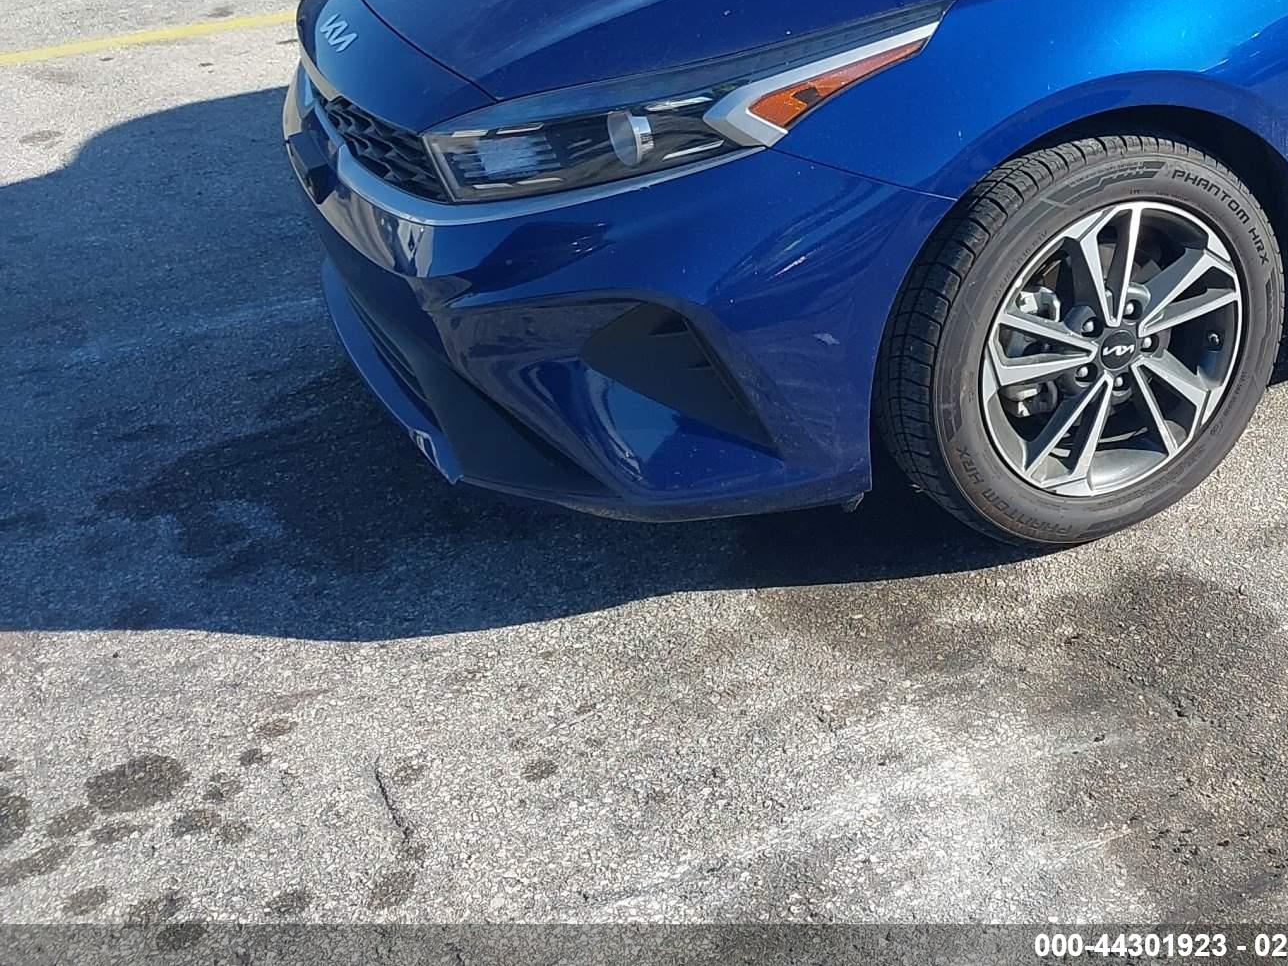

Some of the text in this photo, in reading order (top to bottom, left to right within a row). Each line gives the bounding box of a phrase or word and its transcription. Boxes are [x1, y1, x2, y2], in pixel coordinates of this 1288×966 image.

[320, 13, 359, 53] KIA
[1171, 169, 1250, 225] PHANTOM
[1248, 227, 1269, 265] HRX
